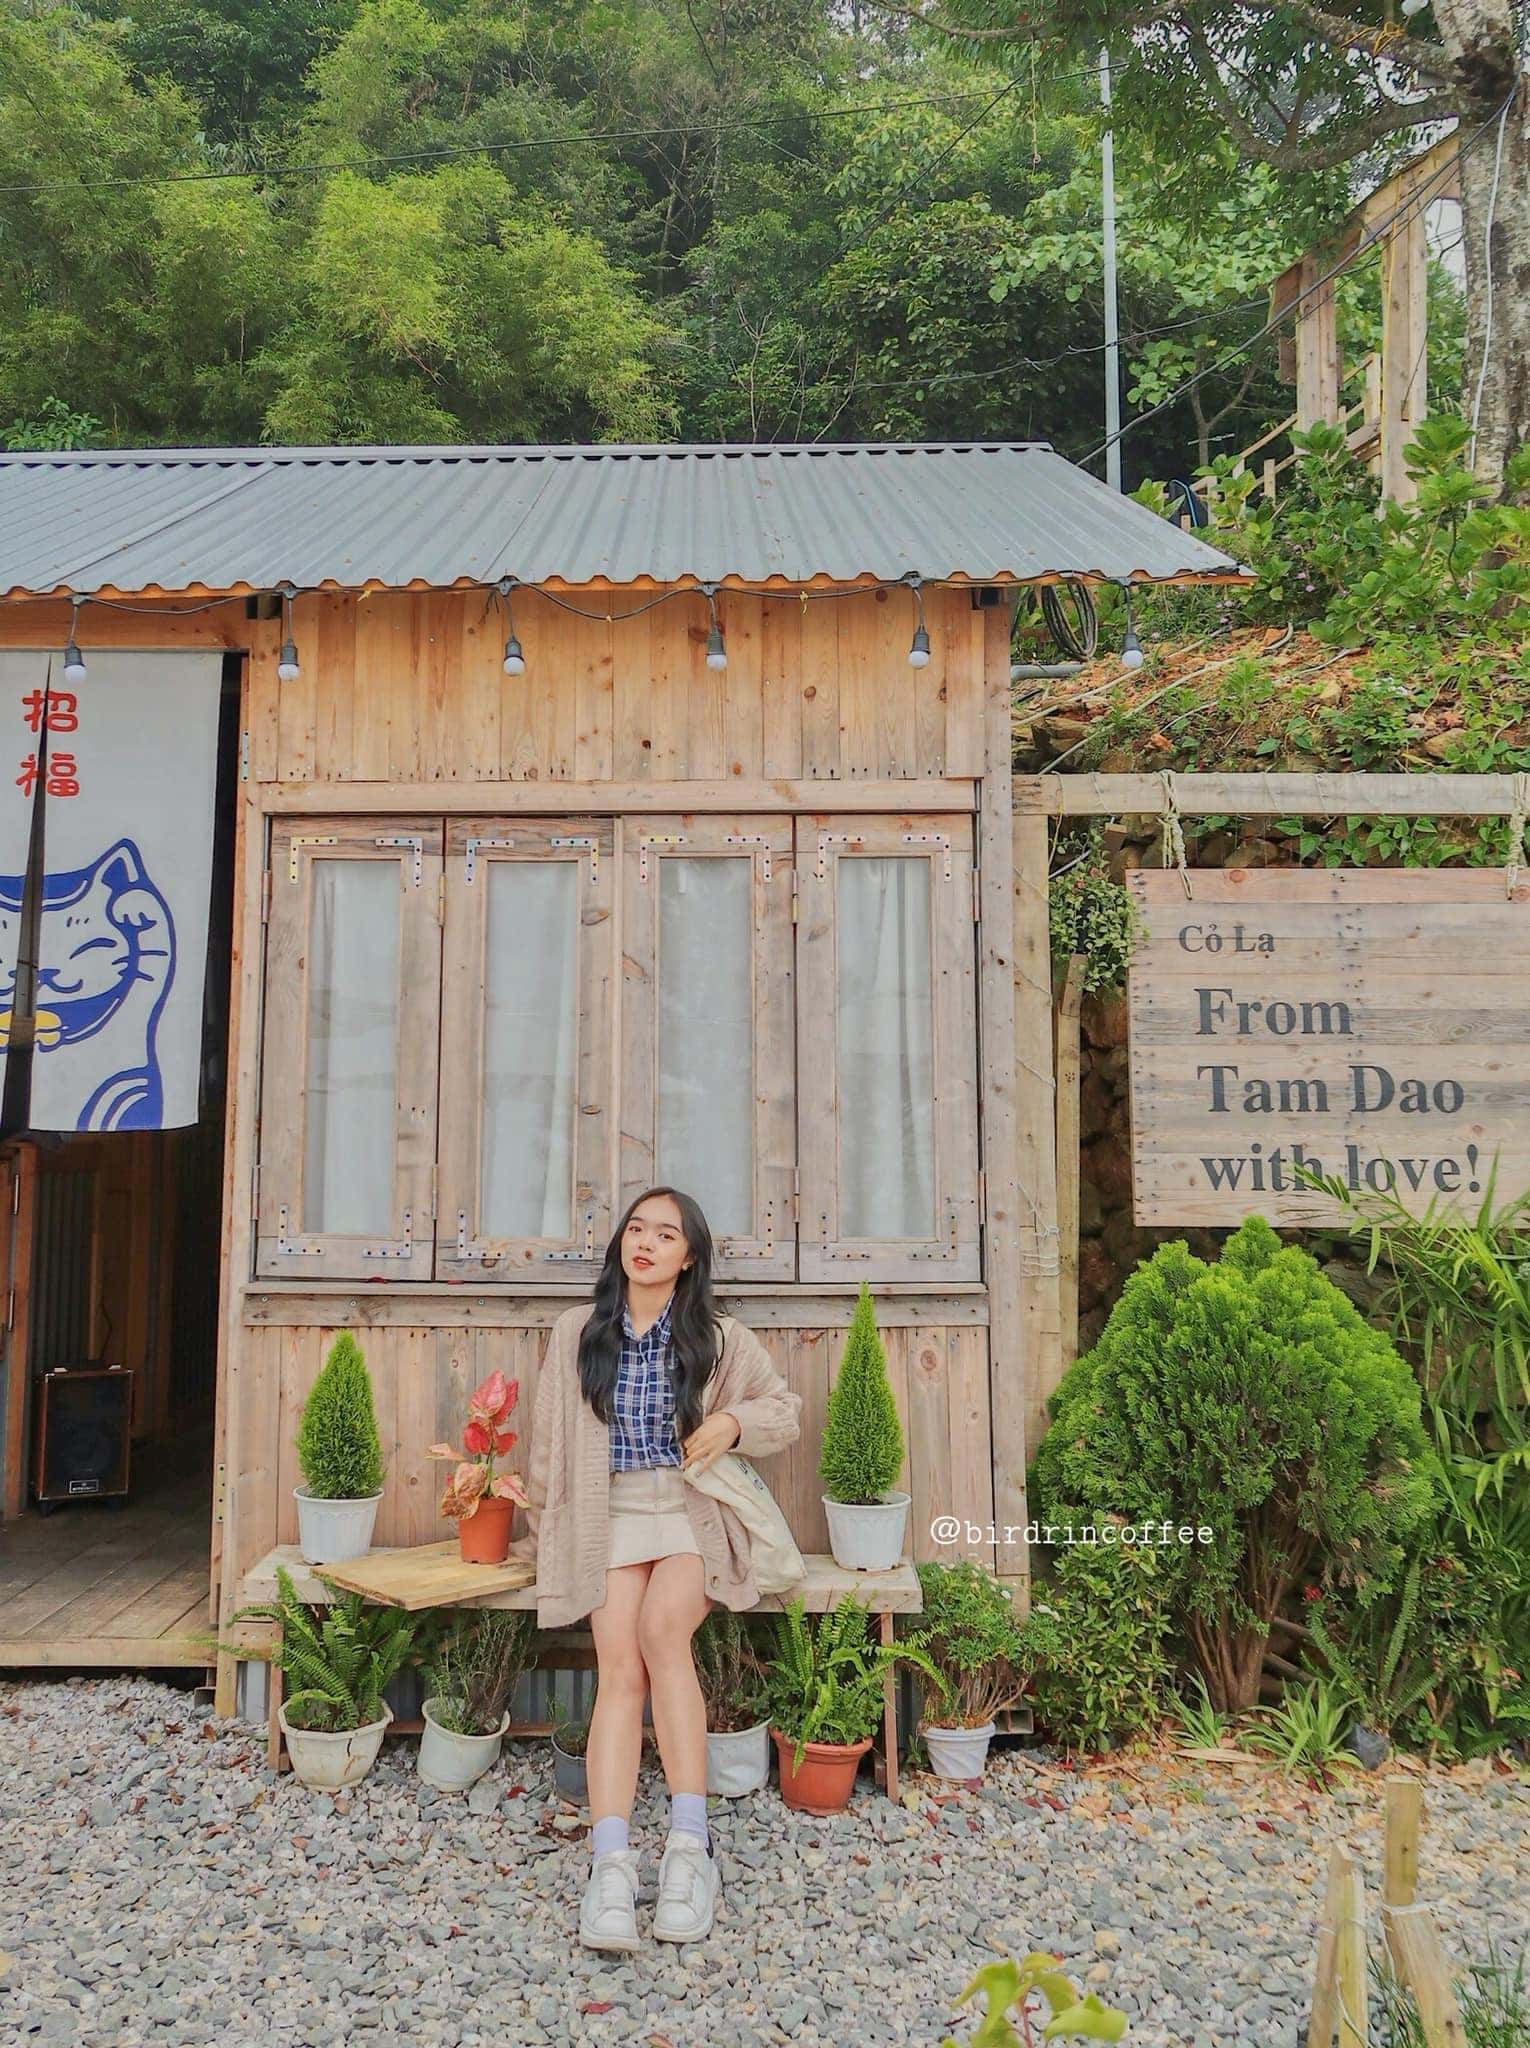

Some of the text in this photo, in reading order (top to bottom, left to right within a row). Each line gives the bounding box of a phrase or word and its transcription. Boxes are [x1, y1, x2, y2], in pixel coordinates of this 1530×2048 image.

[16, 689, 79, 796] 招福
[1178, 923, 1275, 953] Cỏ La
[1194, 988, 1354, 1035] From
[1197, 1065, 1465, 1114] Tam Dao
[1200, 1143, 1481, 1193] with love!
